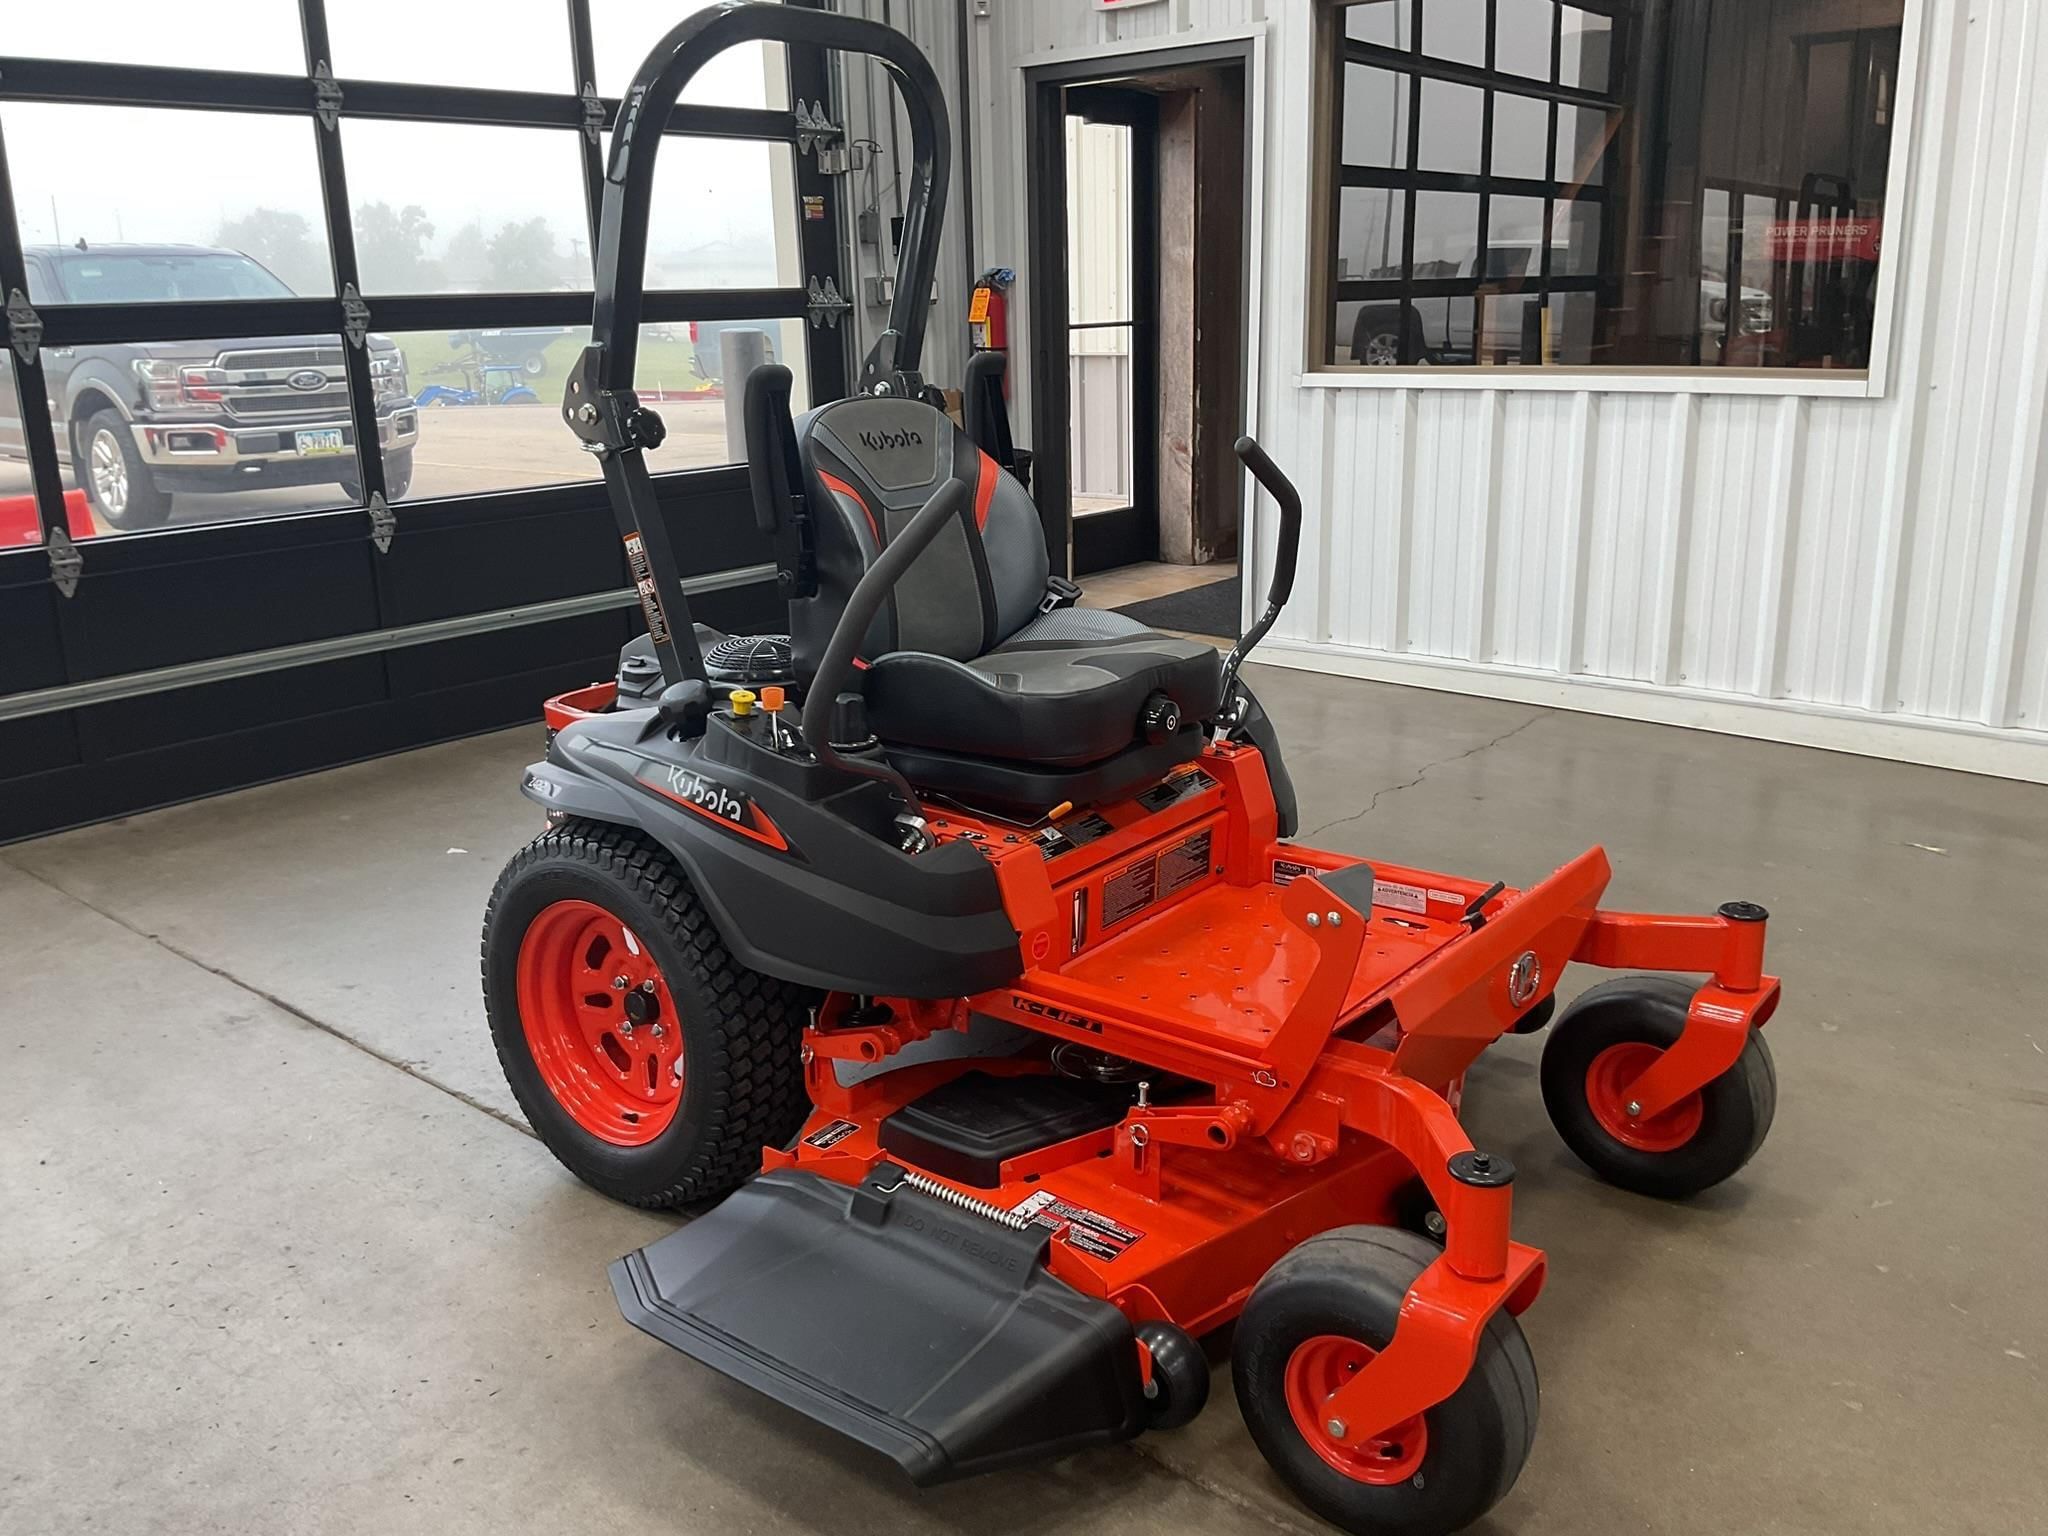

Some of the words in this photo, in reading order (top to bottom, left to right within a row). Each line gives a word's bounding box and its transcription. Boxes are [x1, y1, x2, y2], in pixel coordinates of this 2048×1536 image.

[1766, 226, 1808, 237] POWER
[1810, 225, 1868, 236] PRUNERS
[859, 427, 922, 451] Kubota
[667, 764, 742, 822] Kubota
[1015, 998, 1099, 1030] K-LIFT
[903, 1214, 926, 1232] DO
[930, 1226, 959, 1246] NOT
[960, 1238, 1018, 1273] REMOVE
